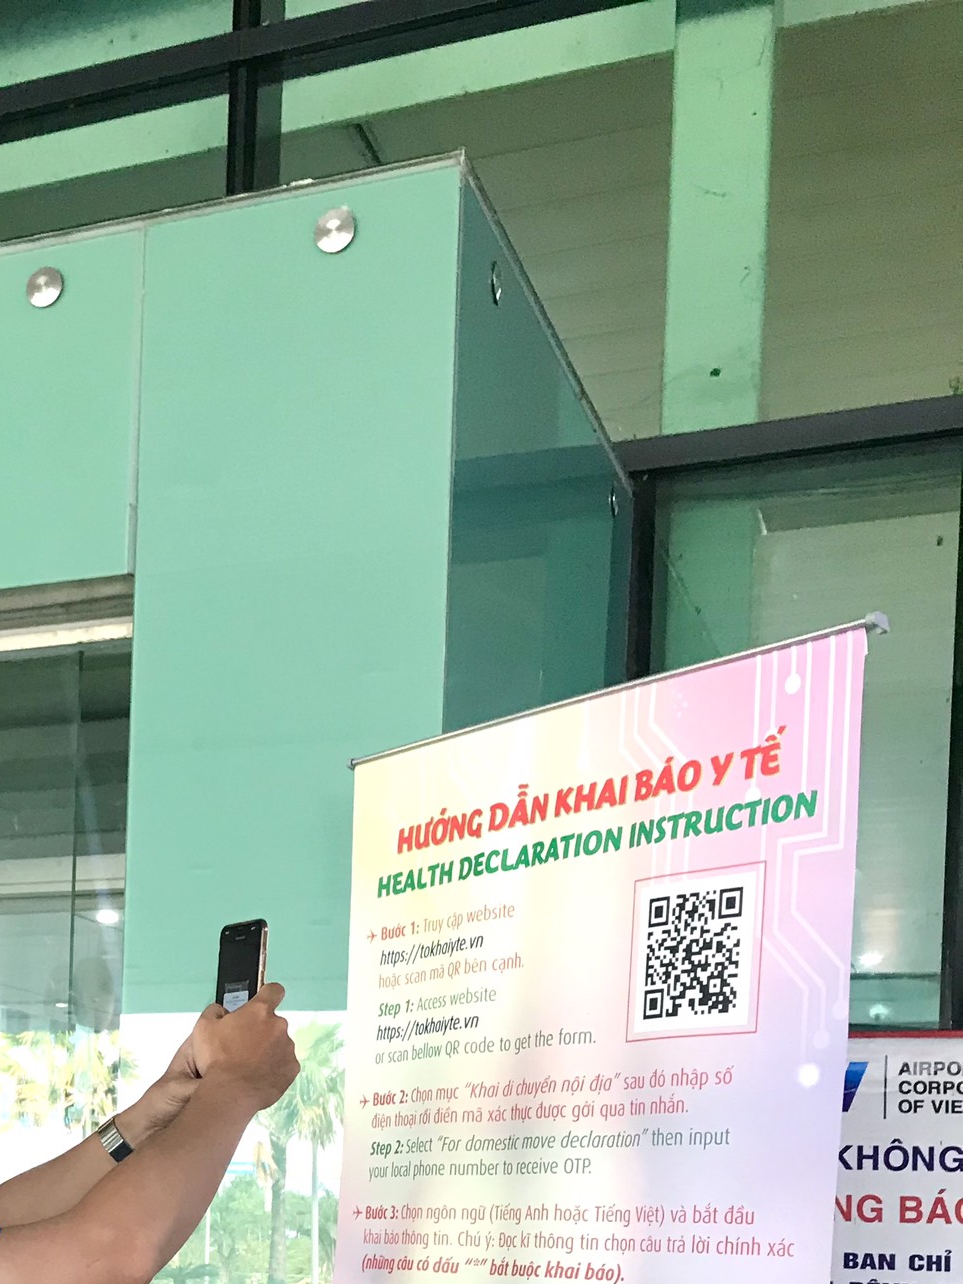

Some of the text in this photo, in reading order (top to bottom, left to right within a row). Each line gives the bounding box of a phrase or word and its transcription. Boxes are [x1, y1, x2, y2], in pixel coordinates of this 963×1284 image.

[397, 725, 788, 854] HƯỚNG DẪN KHAI BÁO Y TẾ
[377, 790, 818, 898] HEALTH DECLARATION INSTRUCTION
[378, 987, 497, 1019] Step 1: Access website
[375, 1028, 597, 1064] or scan bellow QR code to get the form.
[898, 1099, 924, 1114] OF
[370, 1142, 392, 1159] Step
[394, 1141, 404, 1154] 2:
[406, 1138, 432, 1154] Select
[465, 1135, 518, 1152] domestic
[521, 1136, 555, 1149] move
[652, 1128, 683, 1146] then
[689, 1128, 730, 1150] input
[369, 1158, 592, 1182] your local phone number to receive OTP.
[843, 1250, 952, 1272] BAN CHỈ
